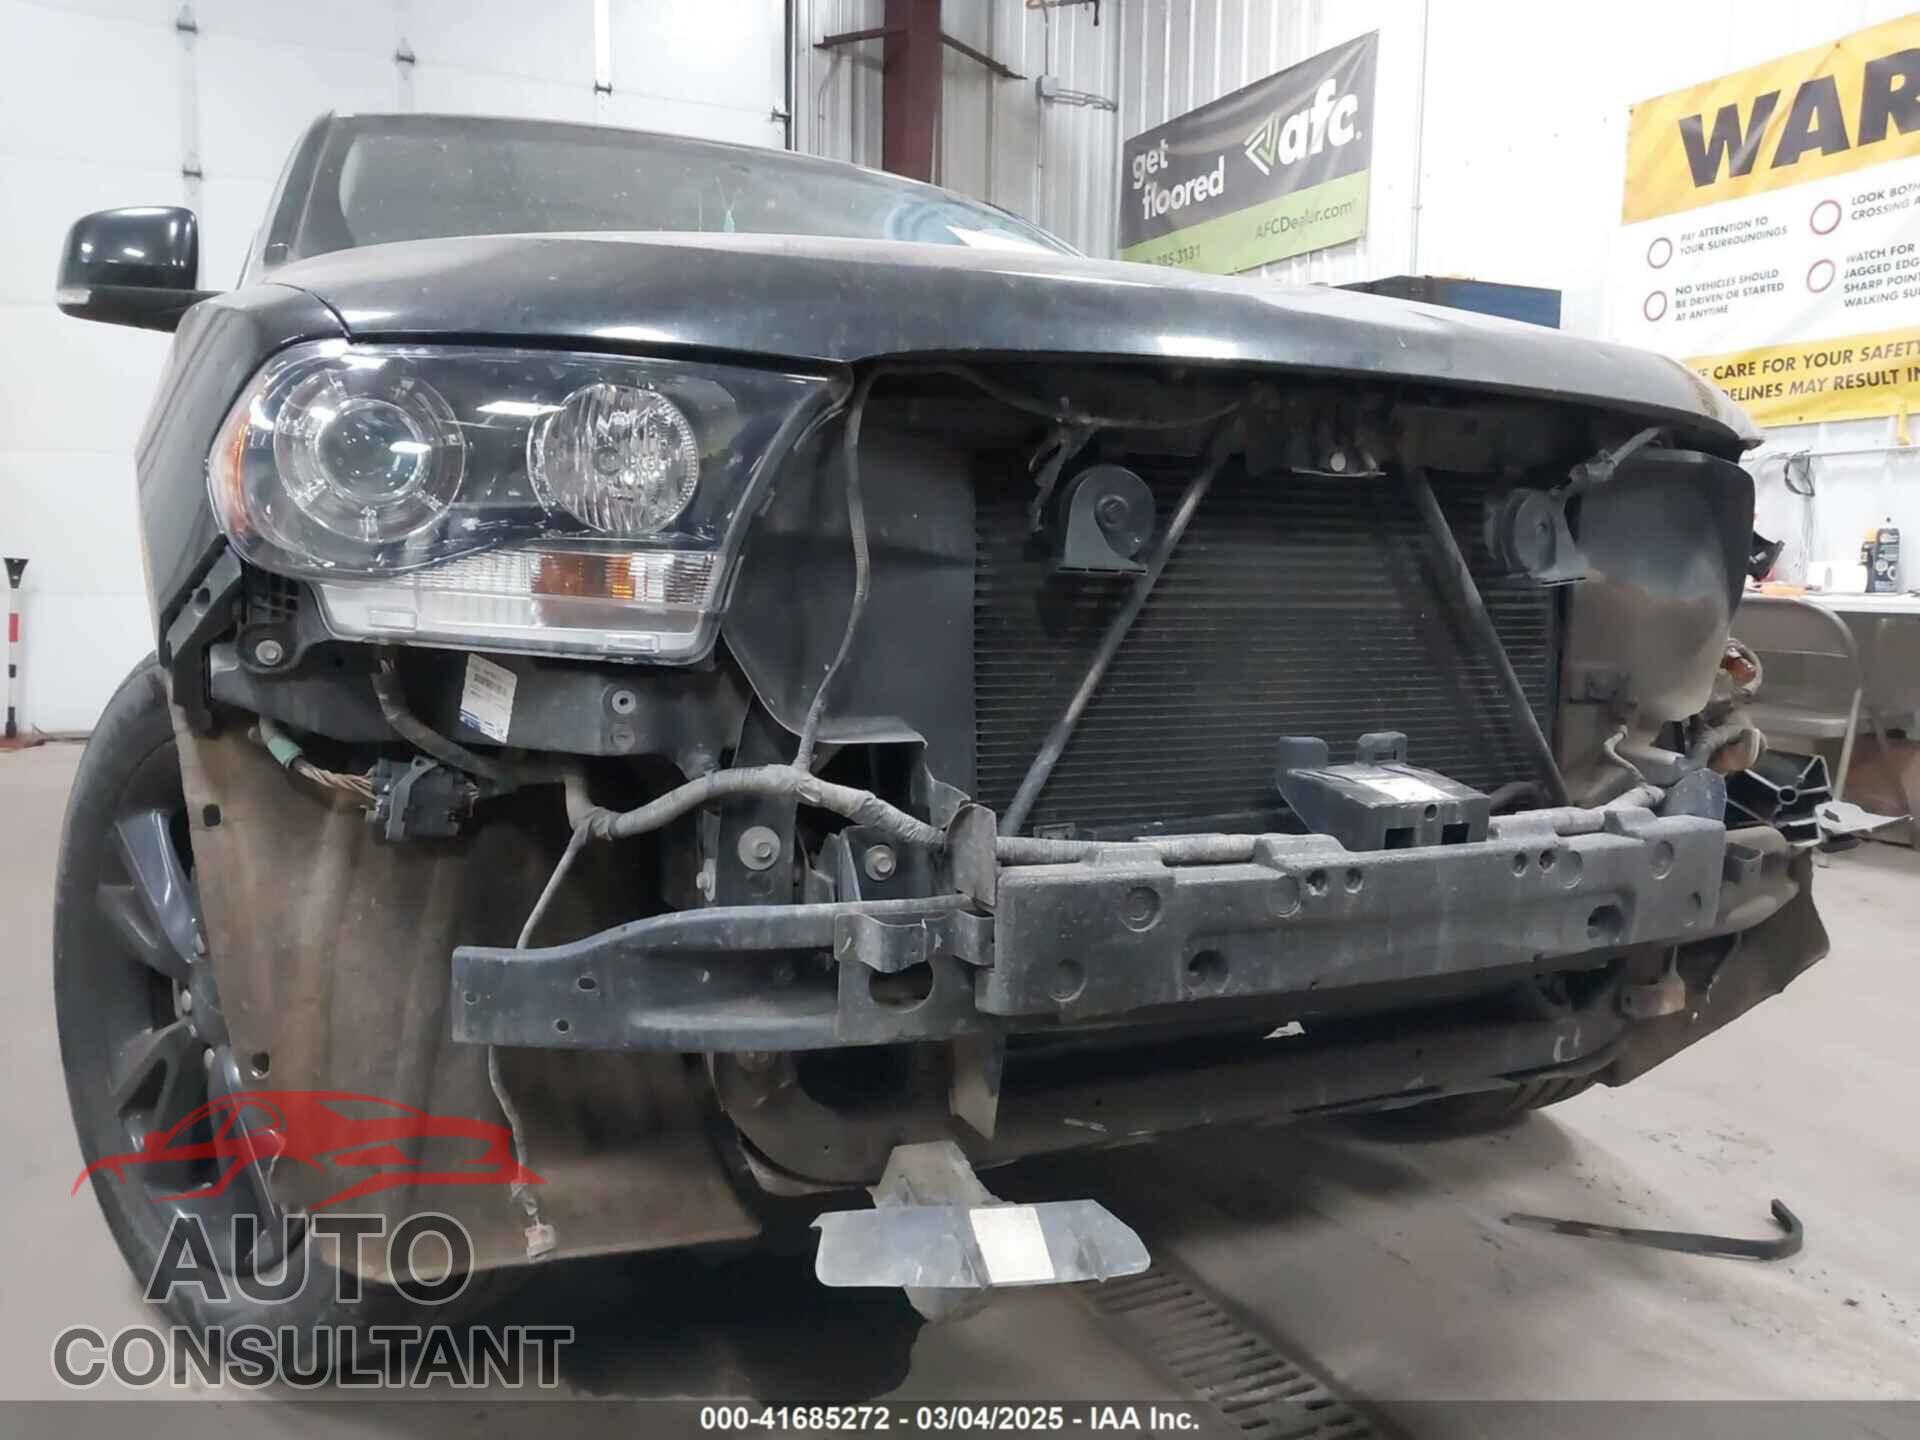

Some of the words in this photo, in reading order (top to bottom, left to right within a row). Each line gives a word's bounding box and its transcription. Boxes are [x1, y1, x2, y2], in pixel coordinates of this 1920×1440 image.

[1679, 48, 1920, 188] WAR
[1132, 139, 1169, 190] get
[1142, 155, 1225, 220] floored
[1851, 191, 1885, 206] LOOK
[1851, 198, 1910, 221] CROSSING
[1680, 243, 1704, 256] YOUR
[1708, 225, 1788, 250] SURROUNDINGS
[1681, 232, 1695, 243] PAY
[1698, 219, 1752, 238] ATTENTION
[1755, 216, 1769, 227] TO
[1846, 248, 1886, 264] WATCH
[1890, 243, 1915, 256] FOR
[1675, 285, 1692, 296] NO
[1695, 277, 1736, 292] VEHICLES
[1739, 268, 1779, 283] SHOULD
[1844, 262, 1892, 280] JAGGED
[1675, 299, 1686, 309] BE
[1689, 294, 1723, 307] DRIVEN
[1726, 289, 1739, 300] OR
[1742, 282, 1785, 297] STARTED
[1844, 279, 1883, 294] SHARP
[1844, 290, 1899, 308] WALKING
[1675, 312, 1686, 321] AT
[1689, 304, 1729, 320] ANYTIME
[1713, 361, 1757, 380] CARE
[1762, 356, 1796, 374] FOR
[1804, 349, 1854, 369] YOUR
[1788, 377, 1829, 395] MAY
[1833, 369, 1900, 391] RESULT
